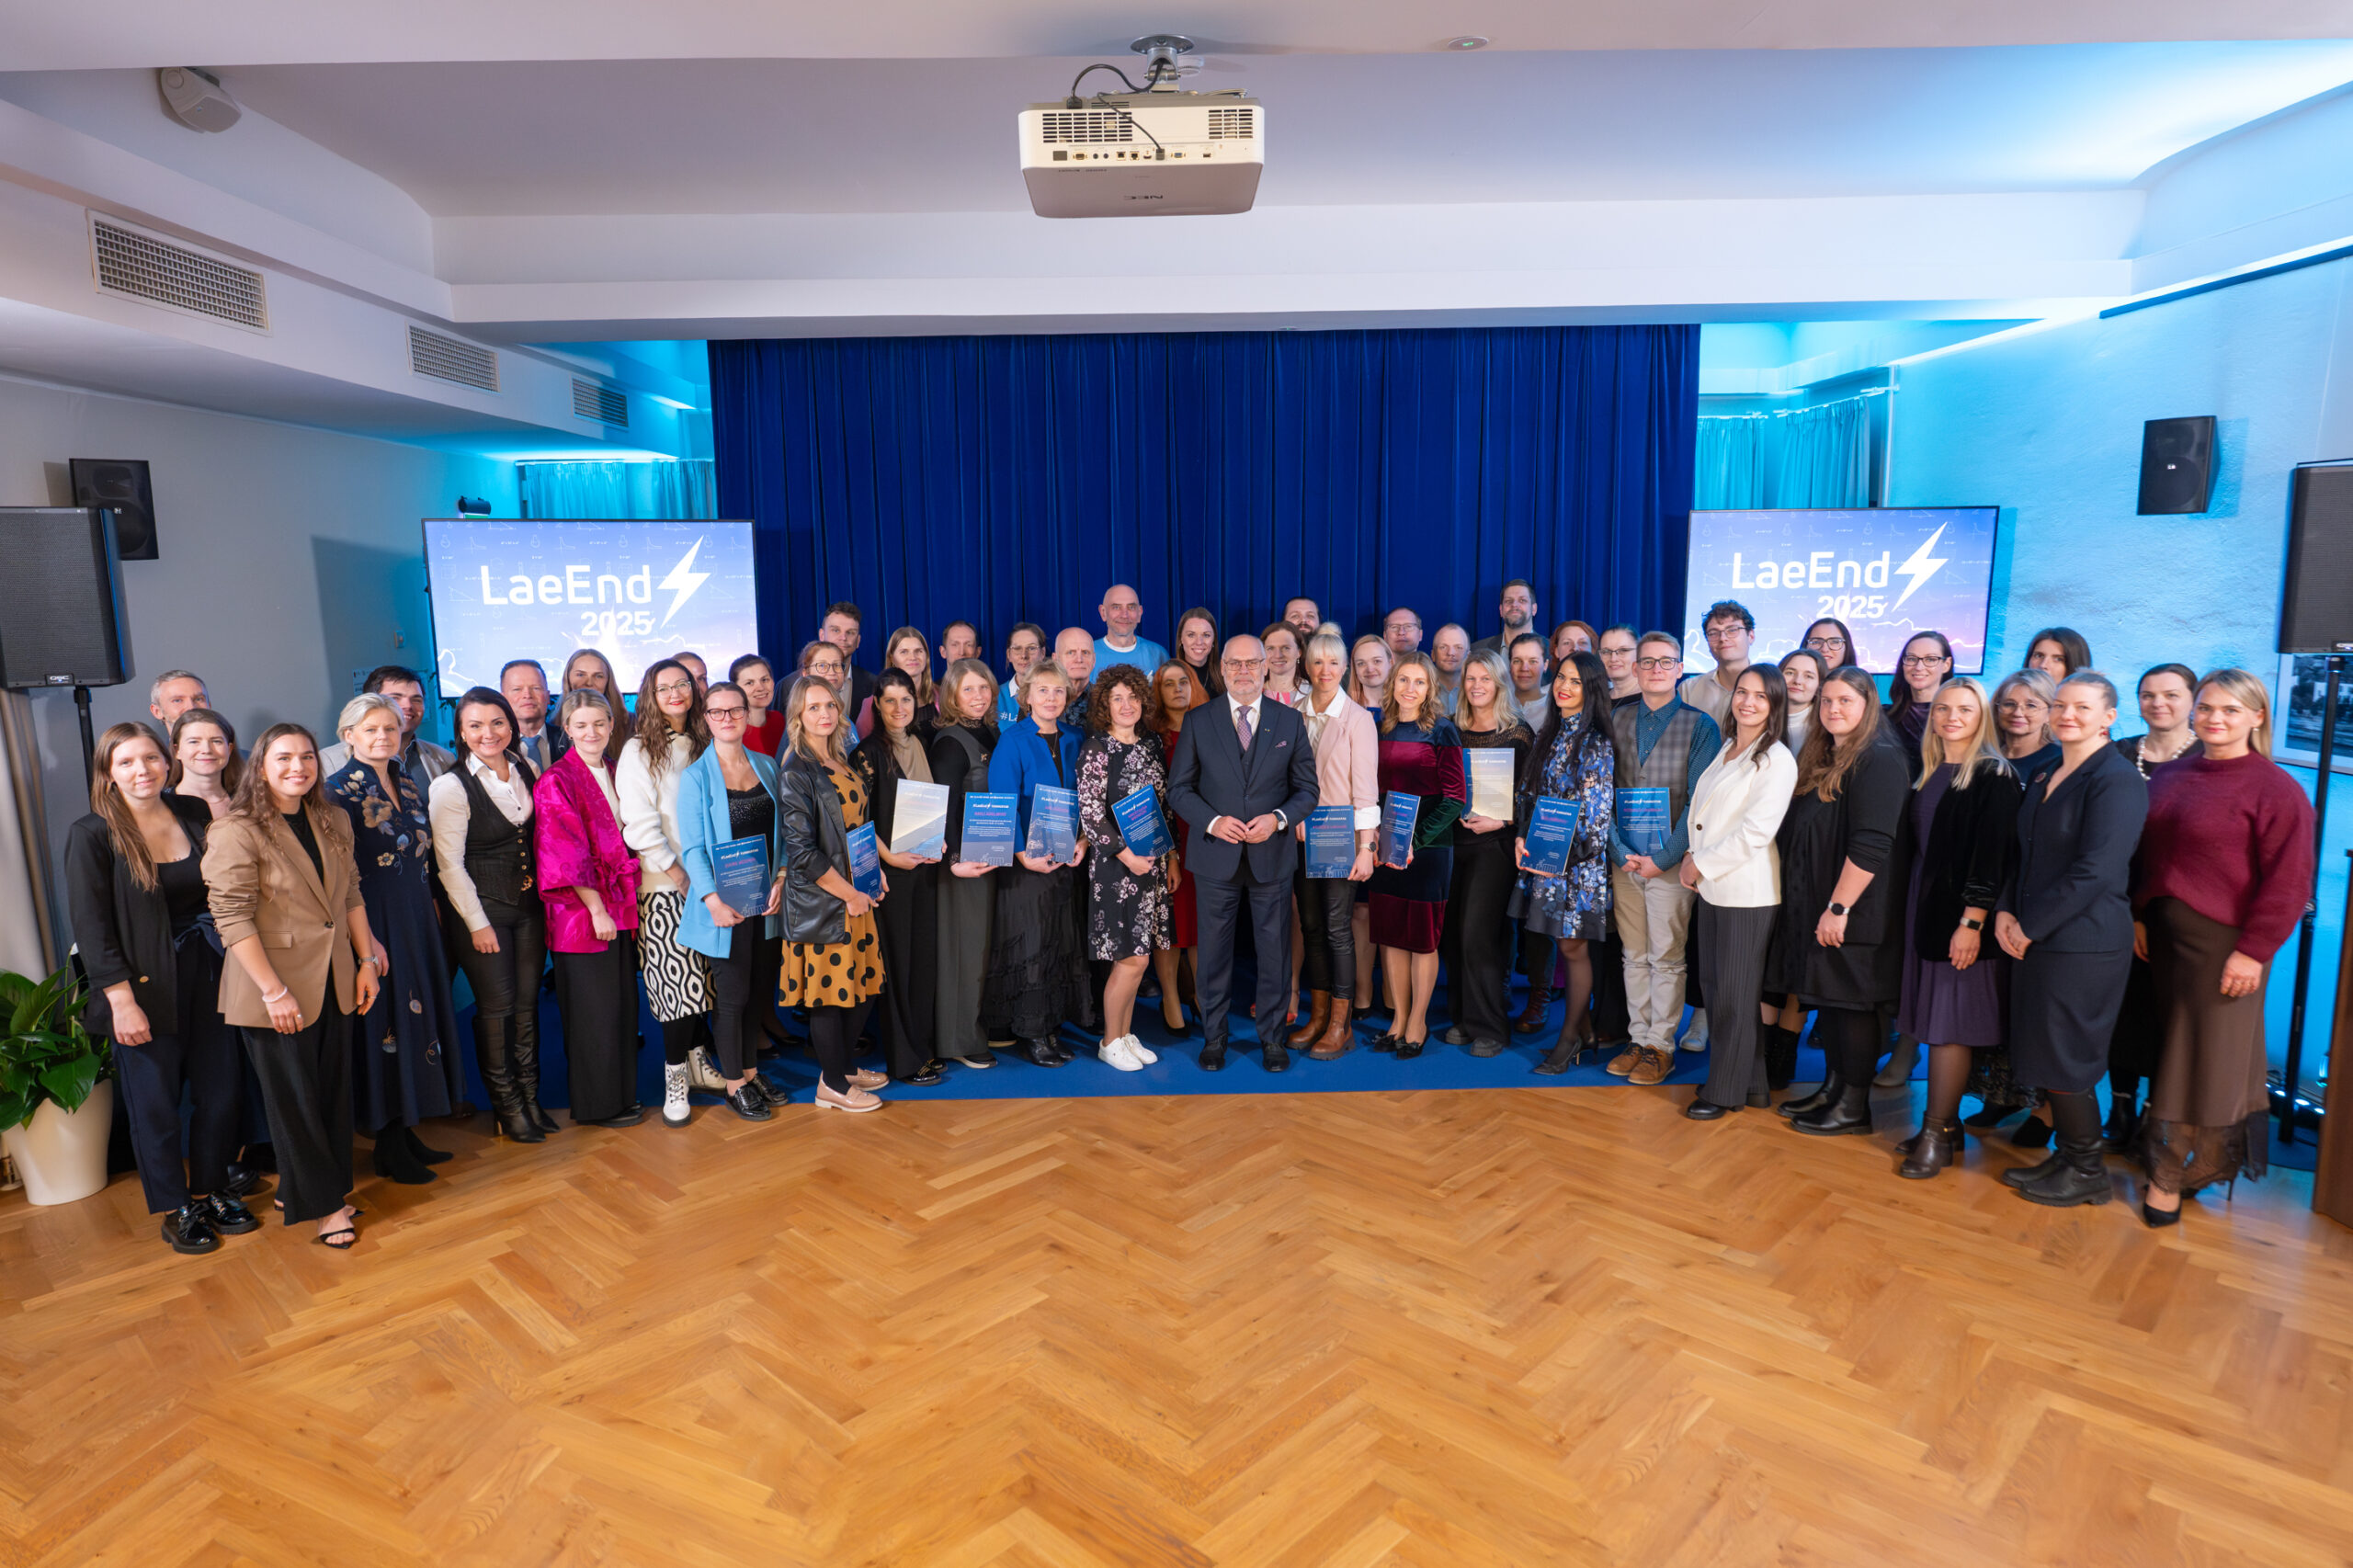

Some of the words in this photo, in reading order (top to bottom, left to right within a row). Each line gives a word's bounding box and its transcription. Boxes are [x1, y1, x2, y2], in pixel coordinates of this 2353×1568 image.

[480, 564, 652, 606] LaeEnd
[1732, 551, 1891, 589] LaeEnd
[580, 610, 654, 636] 2025
[1816, 595, 1886, 619] 2025
